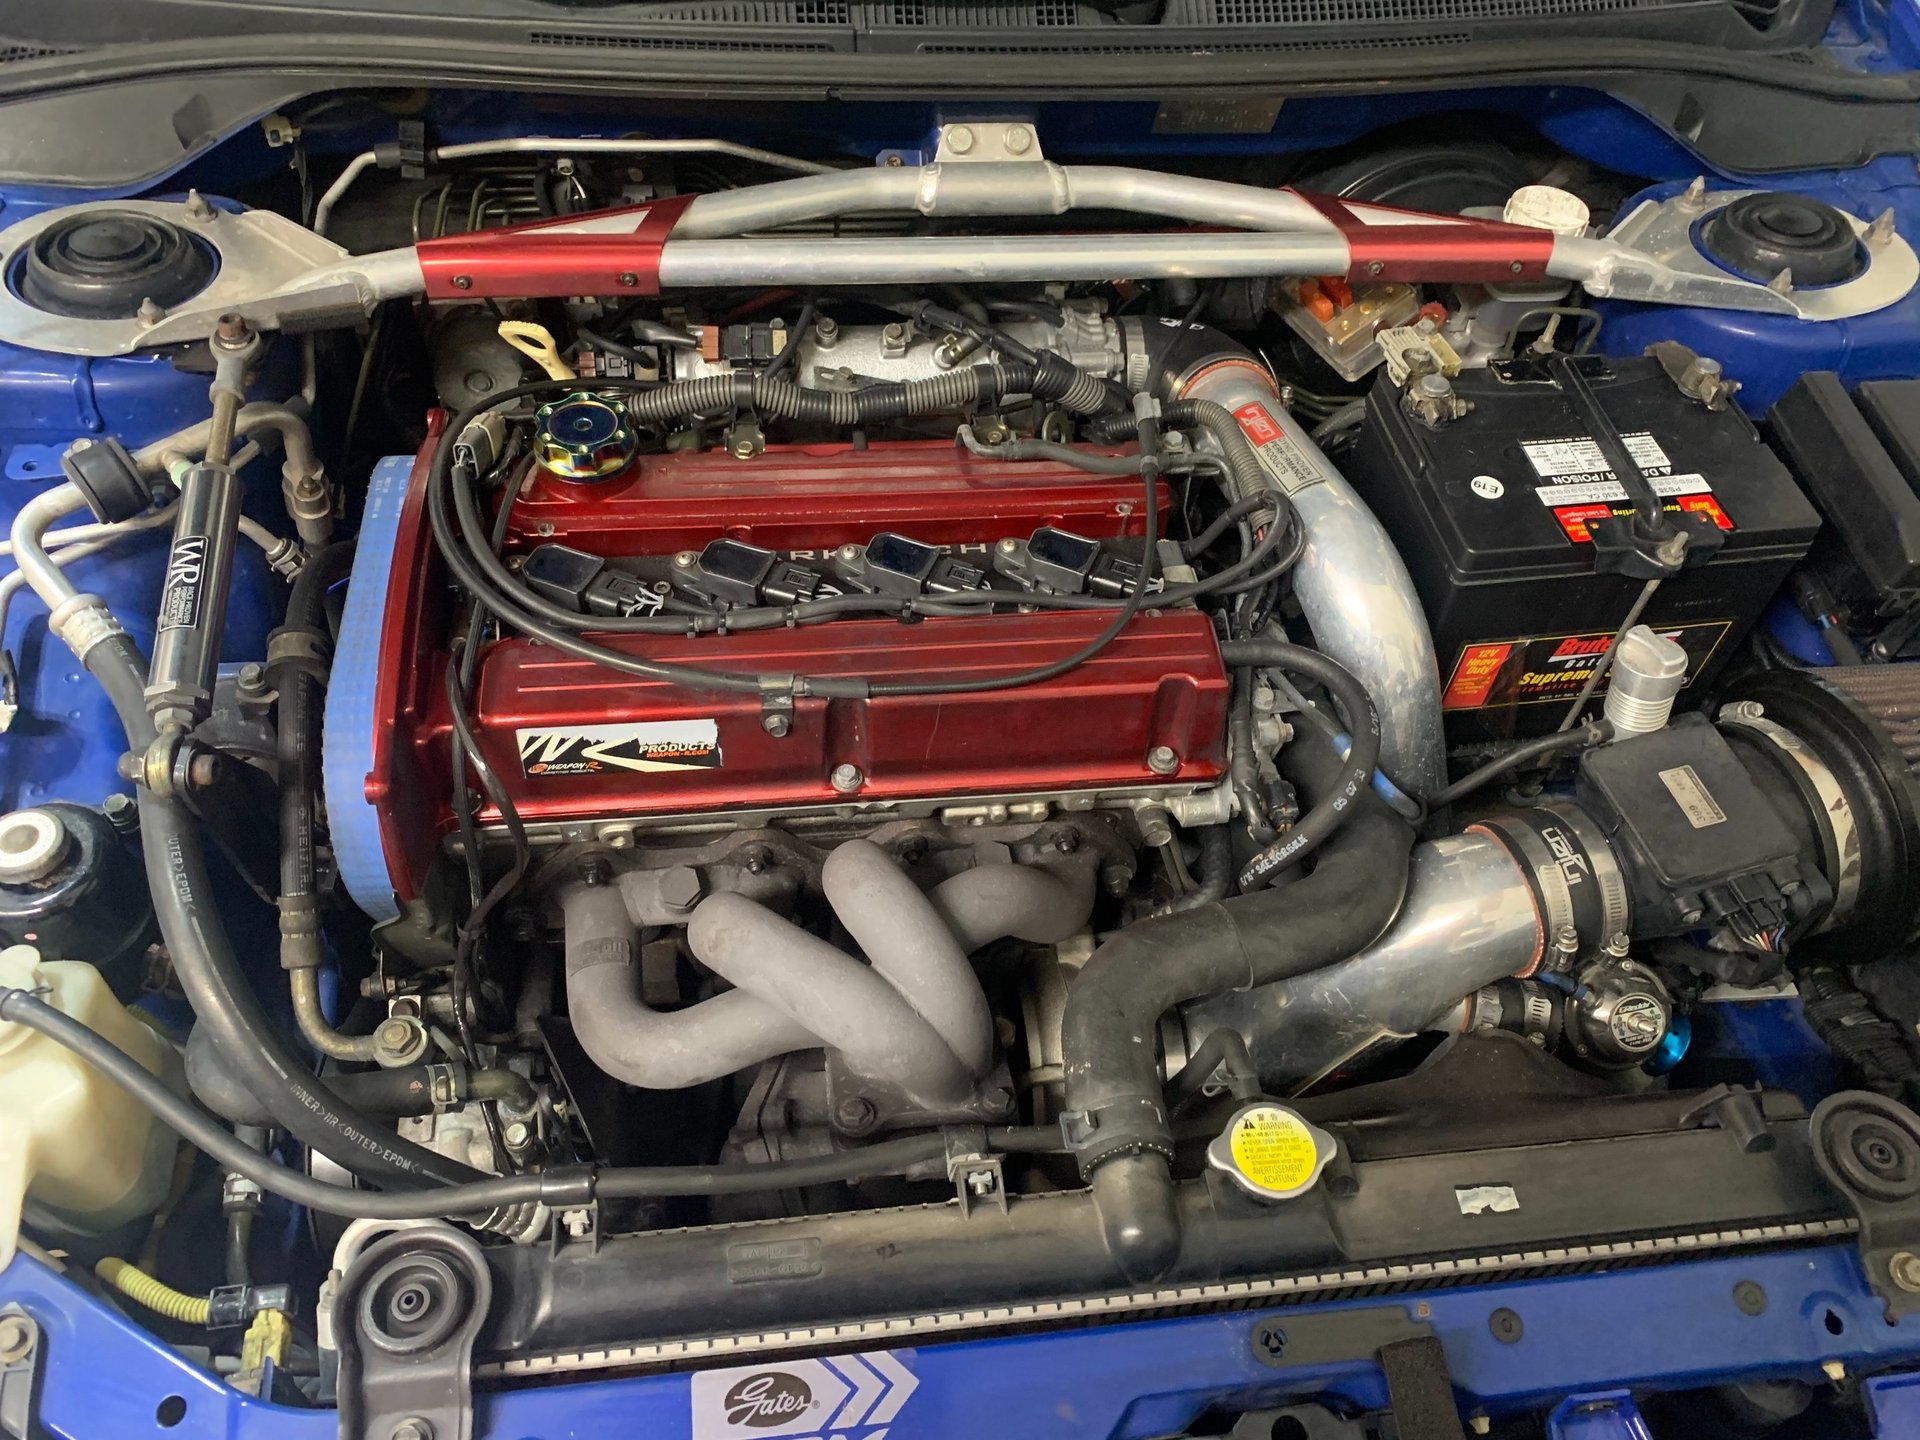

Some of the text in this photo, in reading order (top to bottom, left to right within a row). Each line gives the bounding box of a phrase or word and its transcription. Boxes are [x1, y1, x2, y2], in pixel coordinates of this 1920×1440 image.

[1262, 444, 1289, 476] PRODUCTS
[1270, 440, 1307, 482] PERFORMANCE
[1478, 648, 1500, 659] 12V
[1466, 657, 1500, 668] Heavy
[1466, 665, 1492, 675] Duty
[639, 741, 716, 754] PRODUCTS
[1259, 1121, 1293, 1130] WARNING
[1252, 1164, 1304, 1175] AVERTISSEMENT
[1264, 1174, 1298, 1183] ACHTUNG
[724, 1376, 812, 1426] Gates
